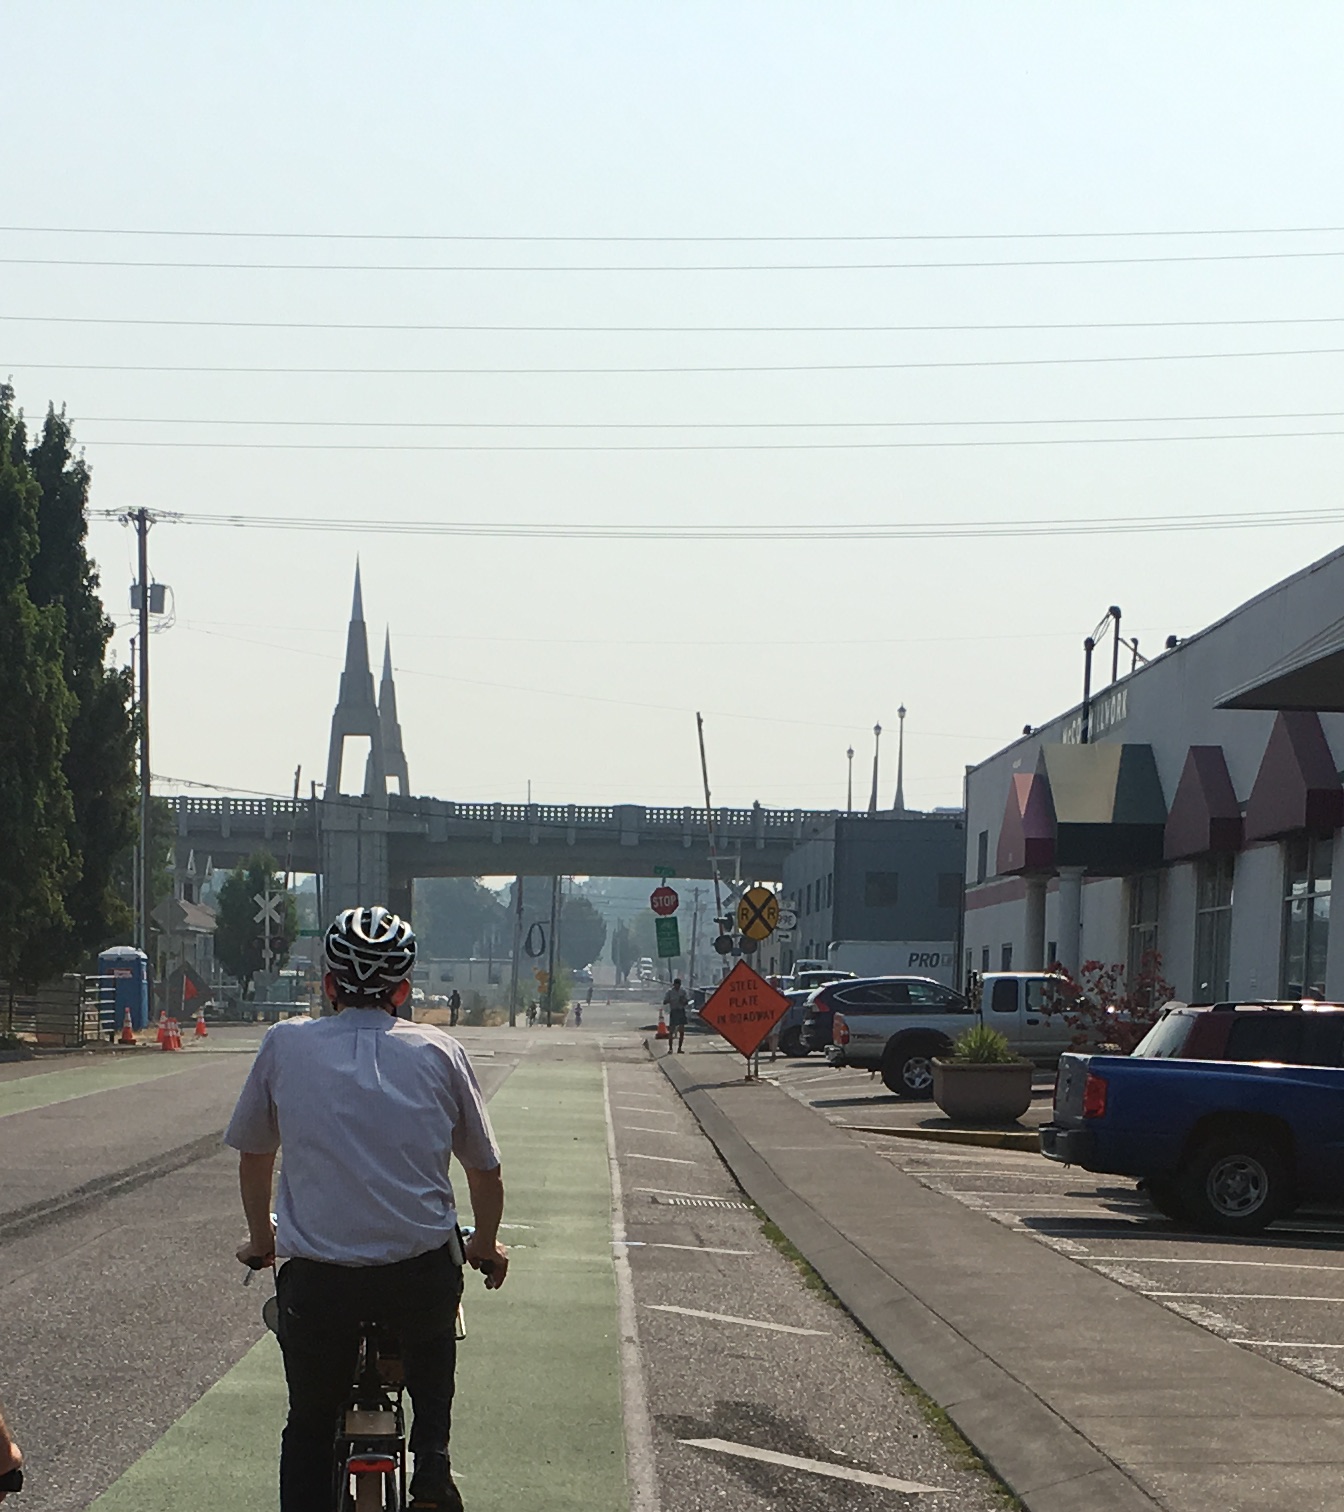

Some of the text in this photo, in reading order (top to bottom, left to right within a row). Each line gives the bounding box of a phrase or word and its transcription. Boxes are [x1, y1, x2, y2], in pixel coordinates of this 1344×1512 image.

[653, 895, 676, 908] STOP
[741, 907, 776, 921] R R
[730, 979, 759, 992] STEEL
[729, 995, 758, 1008] PLATE
[717, 1010, 775, 1024] IN ROADWAY
